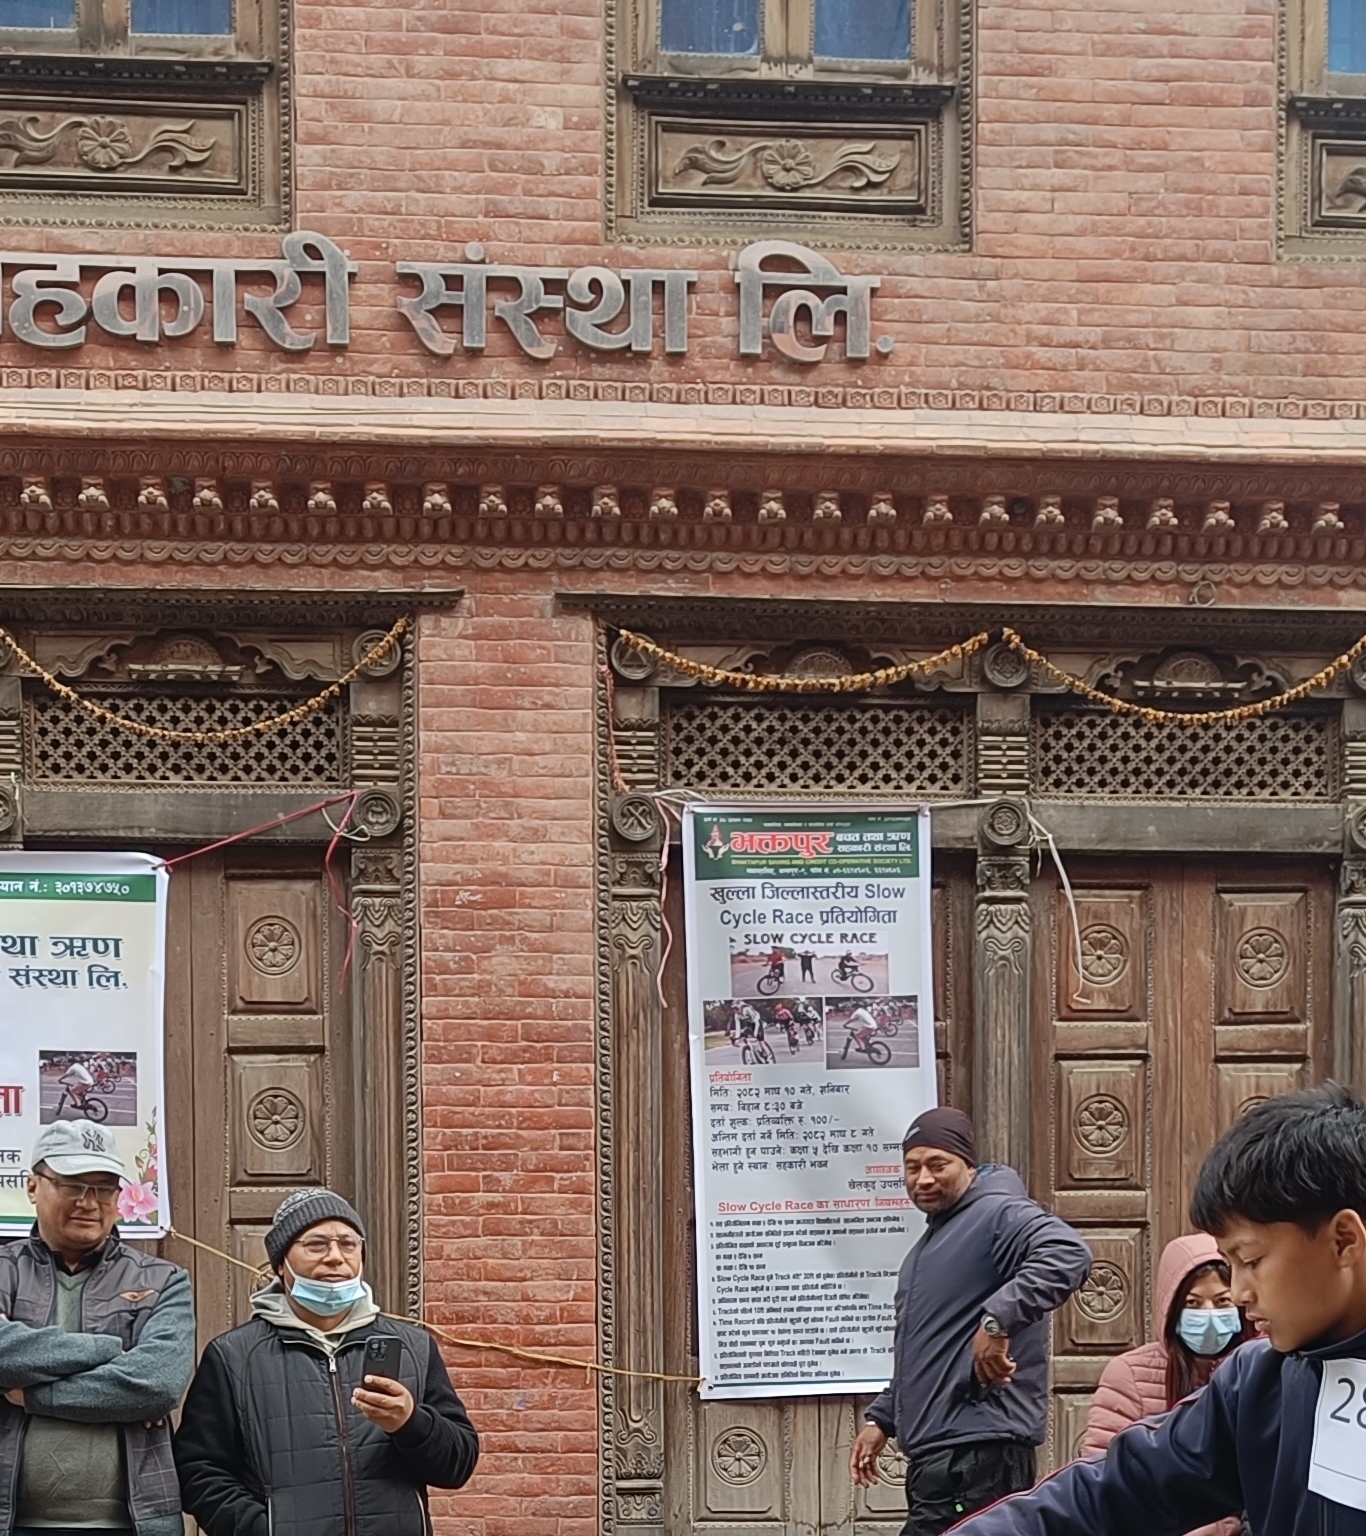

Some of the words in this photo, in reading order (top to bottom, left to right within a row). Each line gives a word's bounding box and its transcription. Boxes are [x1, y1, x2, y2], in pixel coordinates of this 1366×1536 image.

[396, 242, 697, 358] संस्था
[734, 239, 896, 364] लि.
[730, 831, 834, 858] भक्तपुर
[710, 886, 756, 904] खुल्ला
[761, 882, 859, 901] जिल्लास्तरीय
[865, 884, 905, 899] Slow
[720, 909, 766, 928] Cycle
[773, 909, 813, 924] Race
[819, 906, 897, 925] प्रतियोगिता
[49, 935, 124, 960] ऋण
[744, 933, 784, 945] SLOW
[790, 933, 833, 944] CYCLE
[840, 932, 877, 944] RACE
[8, 965, 79, 989] संस्था
[87, 964, 129, 990] लि.
[718, 1202, 746, 1213] Slow
[750, 1201, 781, 1214] Cycle
[786, 1200, 813, 1211] Race
